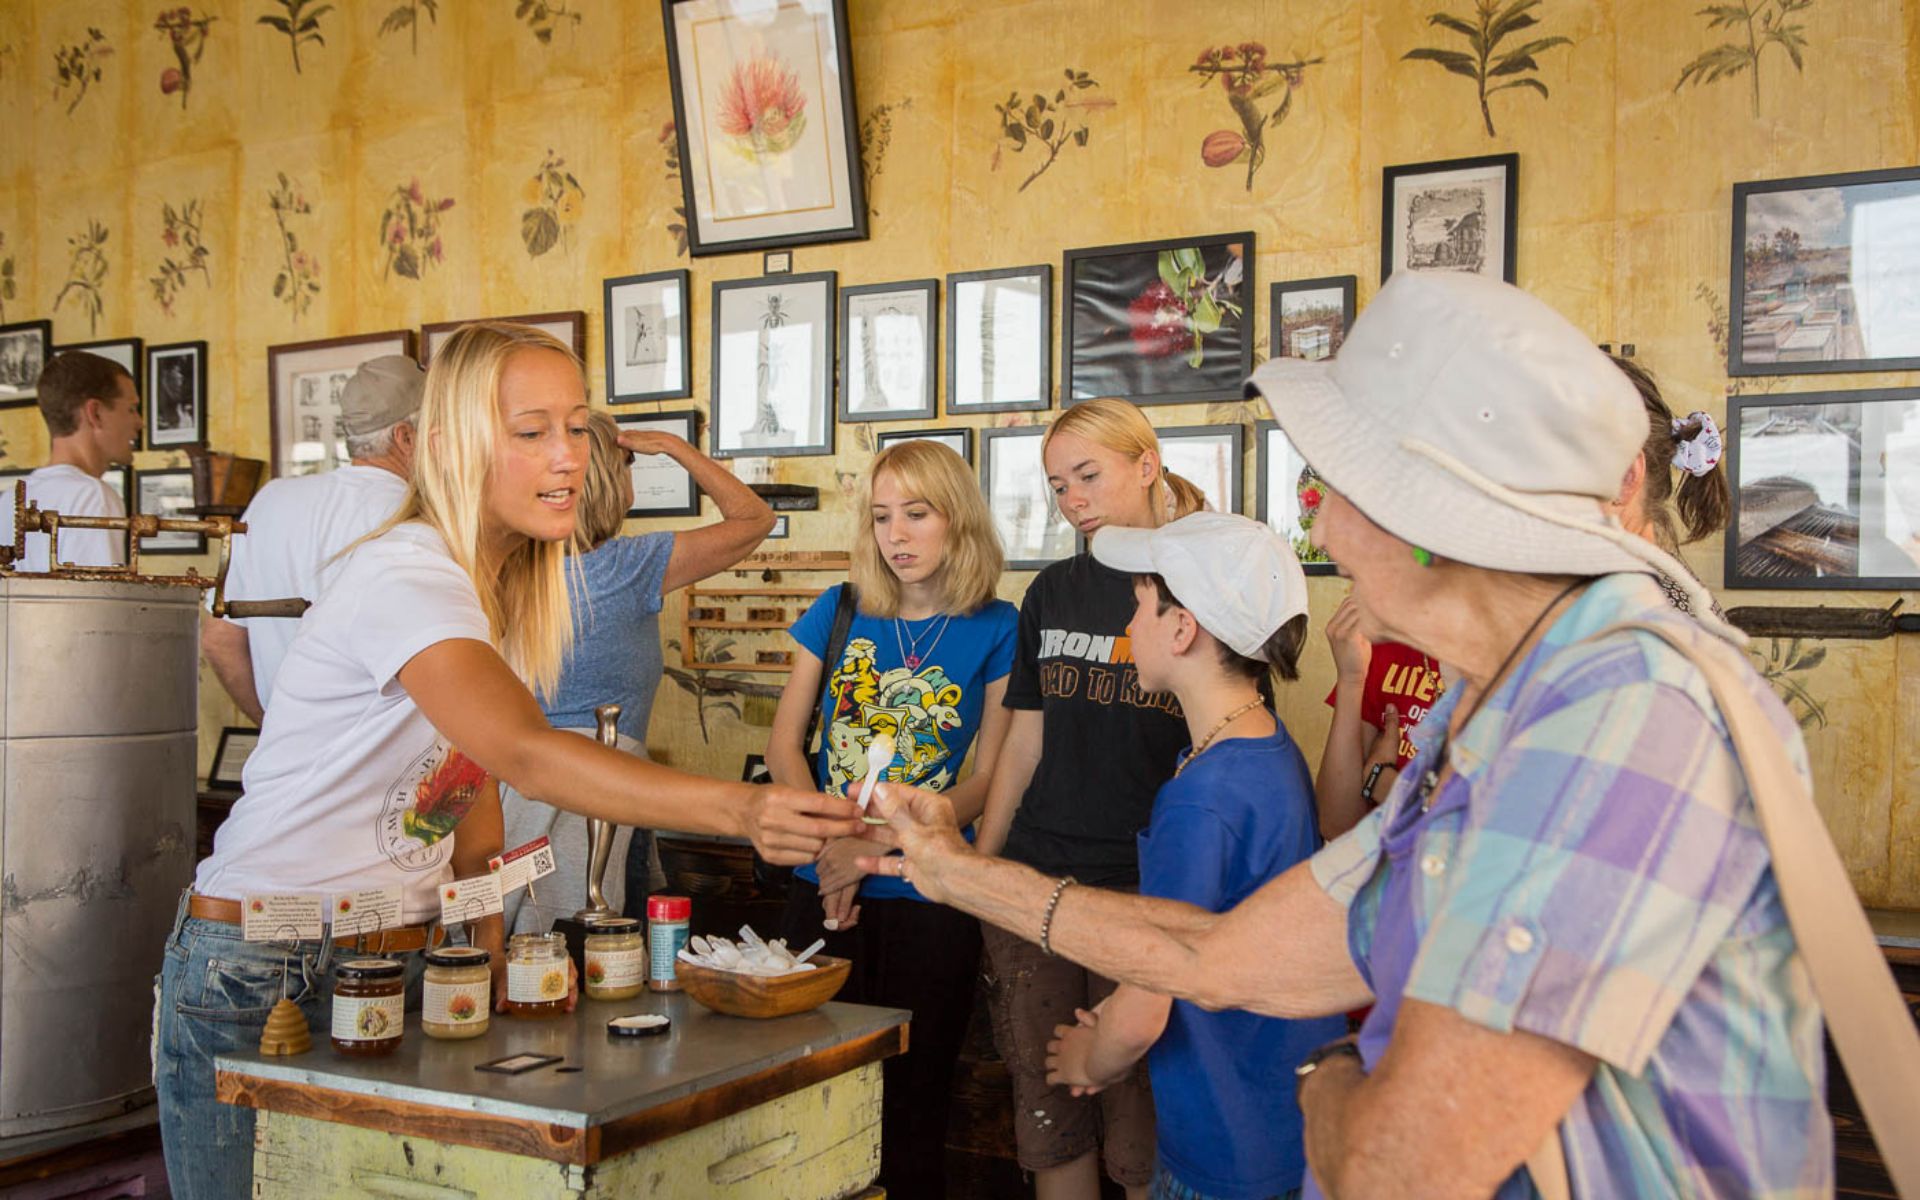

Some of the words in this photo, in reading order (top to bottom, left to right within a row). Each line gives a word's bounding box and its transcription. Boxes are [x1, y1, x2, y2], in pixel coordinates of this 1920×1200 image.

[1038, 628, 1136, 664] IRONM
[1041, 662, 1079, 698] OAD
[1087, 666, 1116, 705] TO
